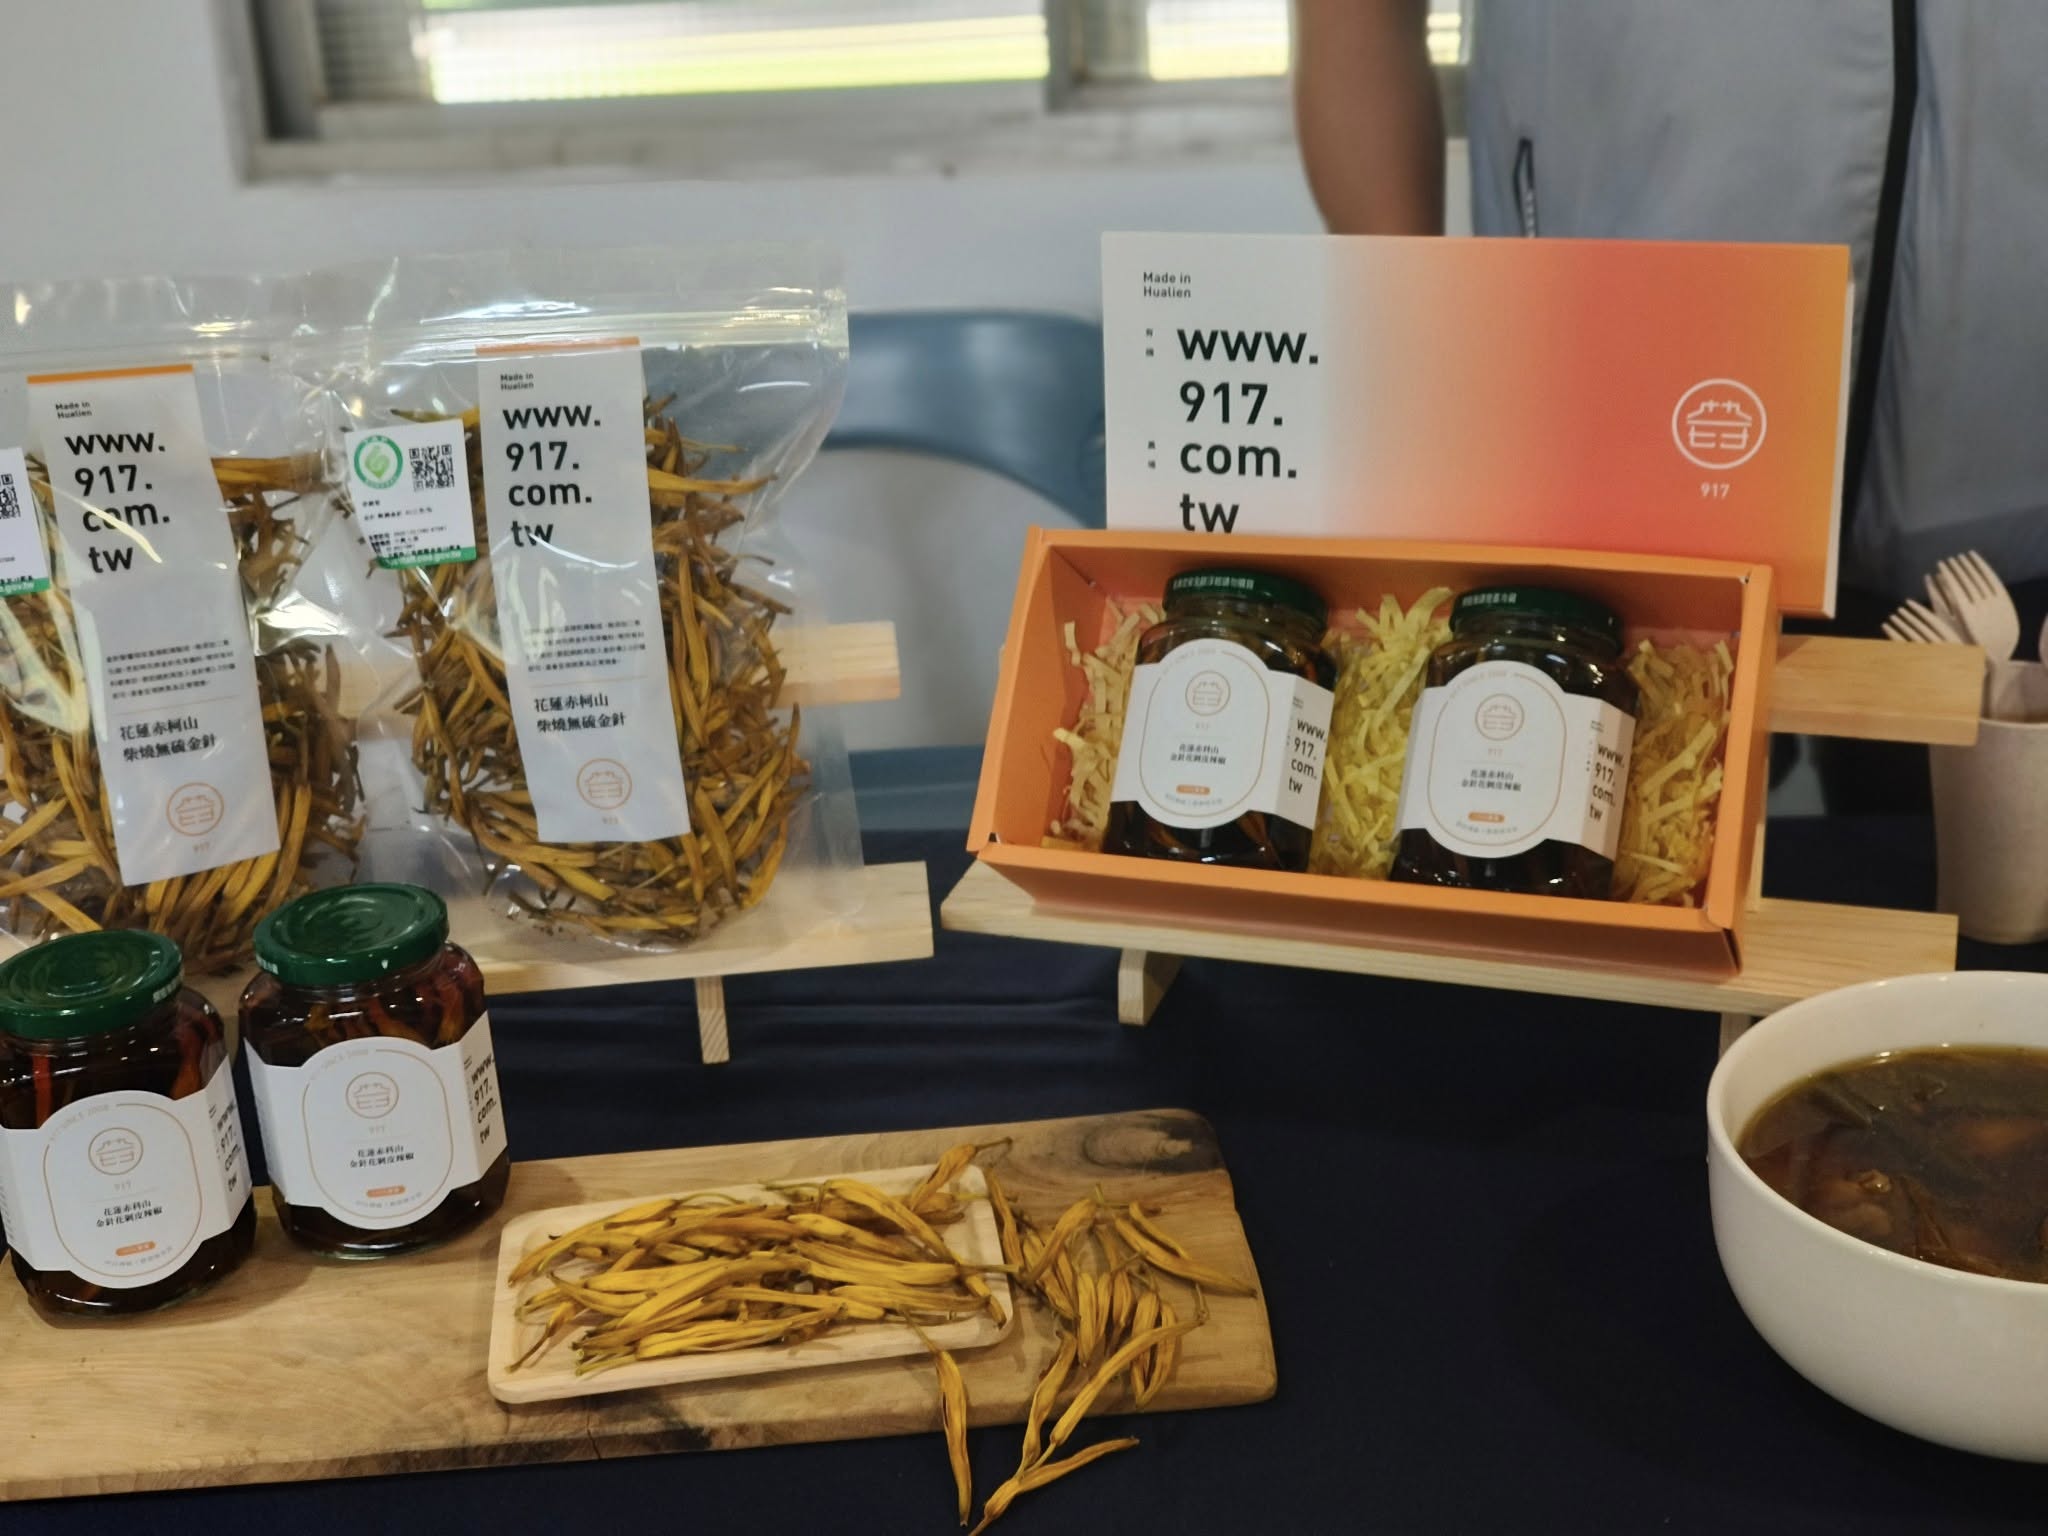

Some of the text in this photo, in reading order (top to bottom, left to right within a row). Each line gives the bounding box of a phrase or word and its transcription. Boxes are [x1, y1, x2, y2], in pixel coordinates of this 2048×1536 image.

[1143, 272, 1191, 284] Made in
[1143, 286, 1191, 298] Hualien
[1177, 329, 1318, 364] www.
[1180, 381, 1283, 426] 917.
[503, 405, 600, 429] www.
[64, 432, 165, 456] www.
[506, 441, 579, 471] 917.
[1180, 442, 1297, 478] com.
[74, 464, 152, 497] 917.
[1701, 482, 1730, 498] 917
[508, 482, 592, 506] com.
[82, 502, 170, 532] com.
[1180, 493, 1239, 533] tw
[511, 520, 554, 547] tw
[88, 546, 134, 574] tw
[1297, 719, 1327, 743] www.
[1294, 737, 1317, 760] 917.
[1291, 759, 1317, 779] com.
[1289, 776, 1303, 794] tw
